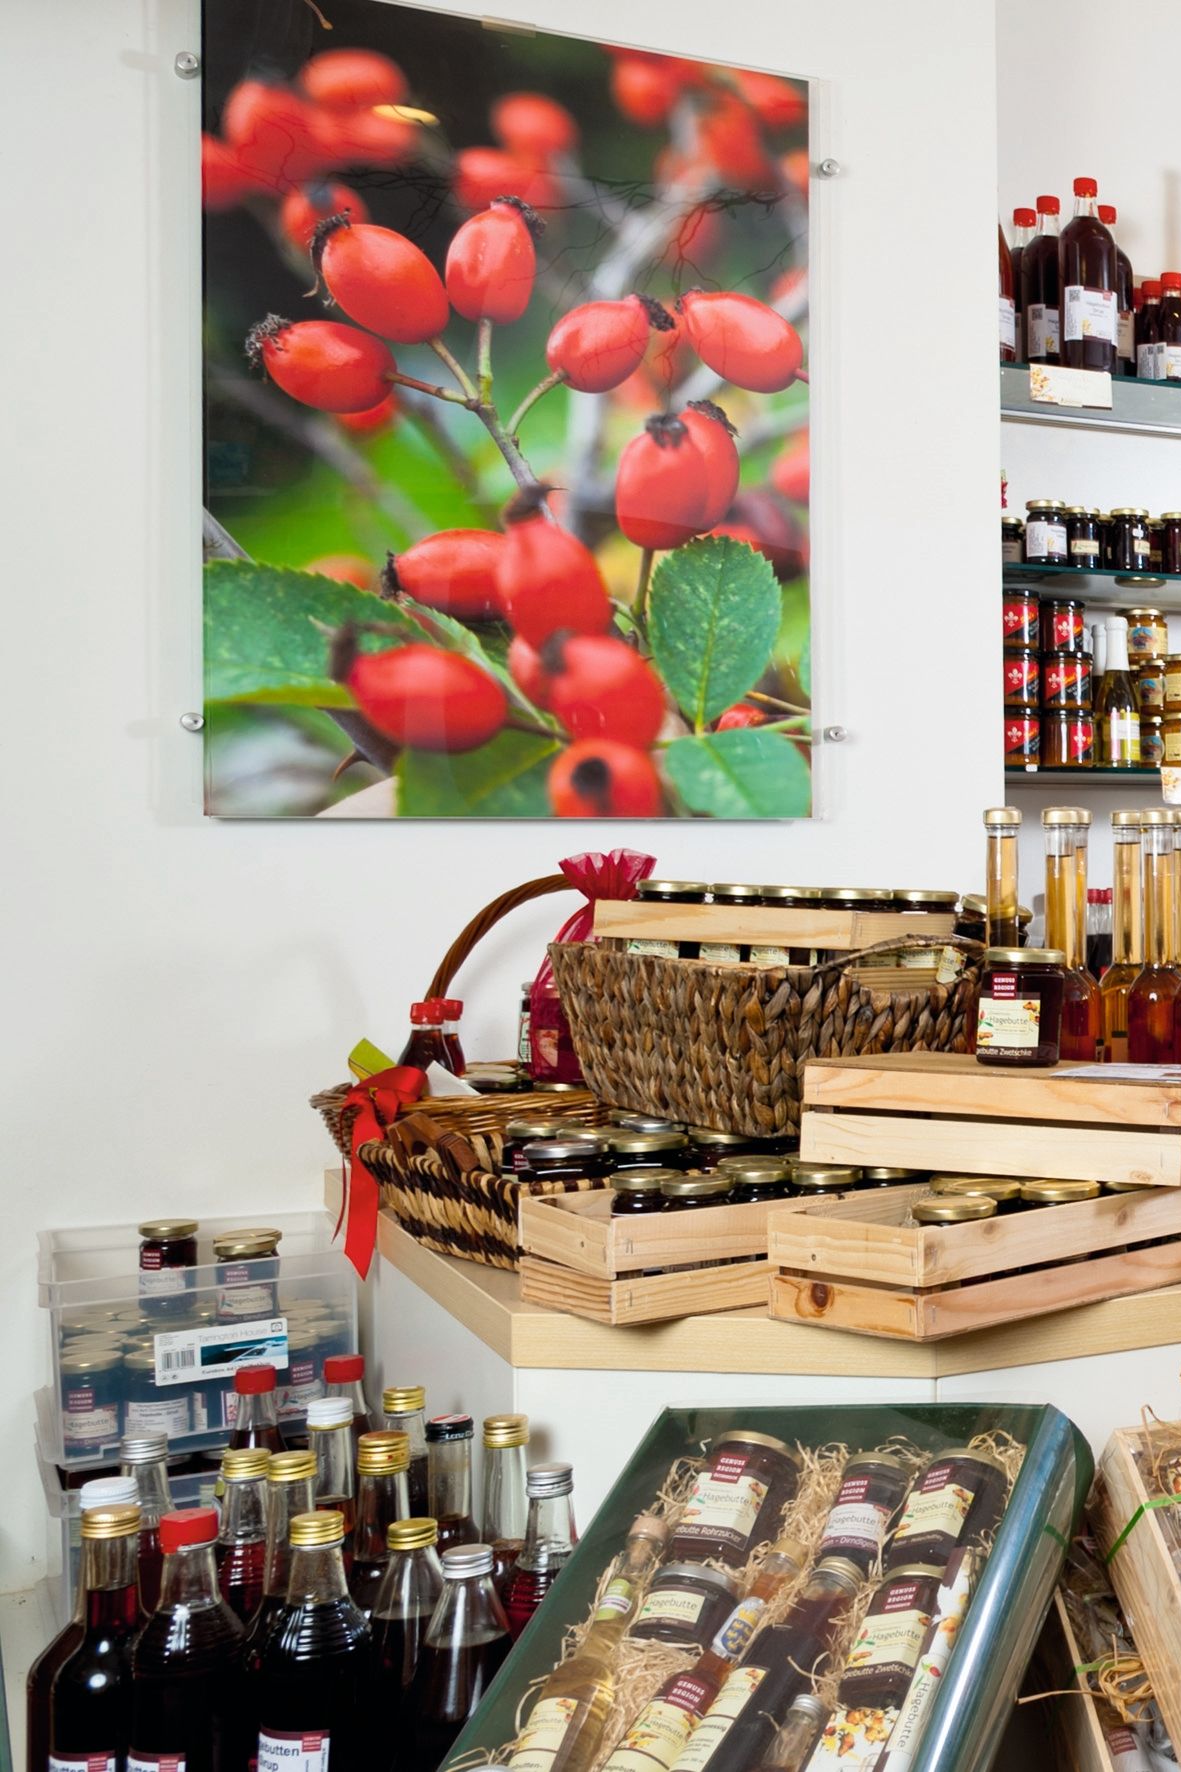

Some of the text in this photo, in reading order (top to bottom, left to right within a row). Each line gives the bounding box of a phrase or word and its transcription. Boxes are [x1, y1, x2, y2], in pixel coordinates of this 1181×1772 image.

[702, 1491, 750, 1506] Hagebutte
[871, 1627, 921, 1642] Hagebutte
[896, 1680, 931, 1749] Hagebutte
